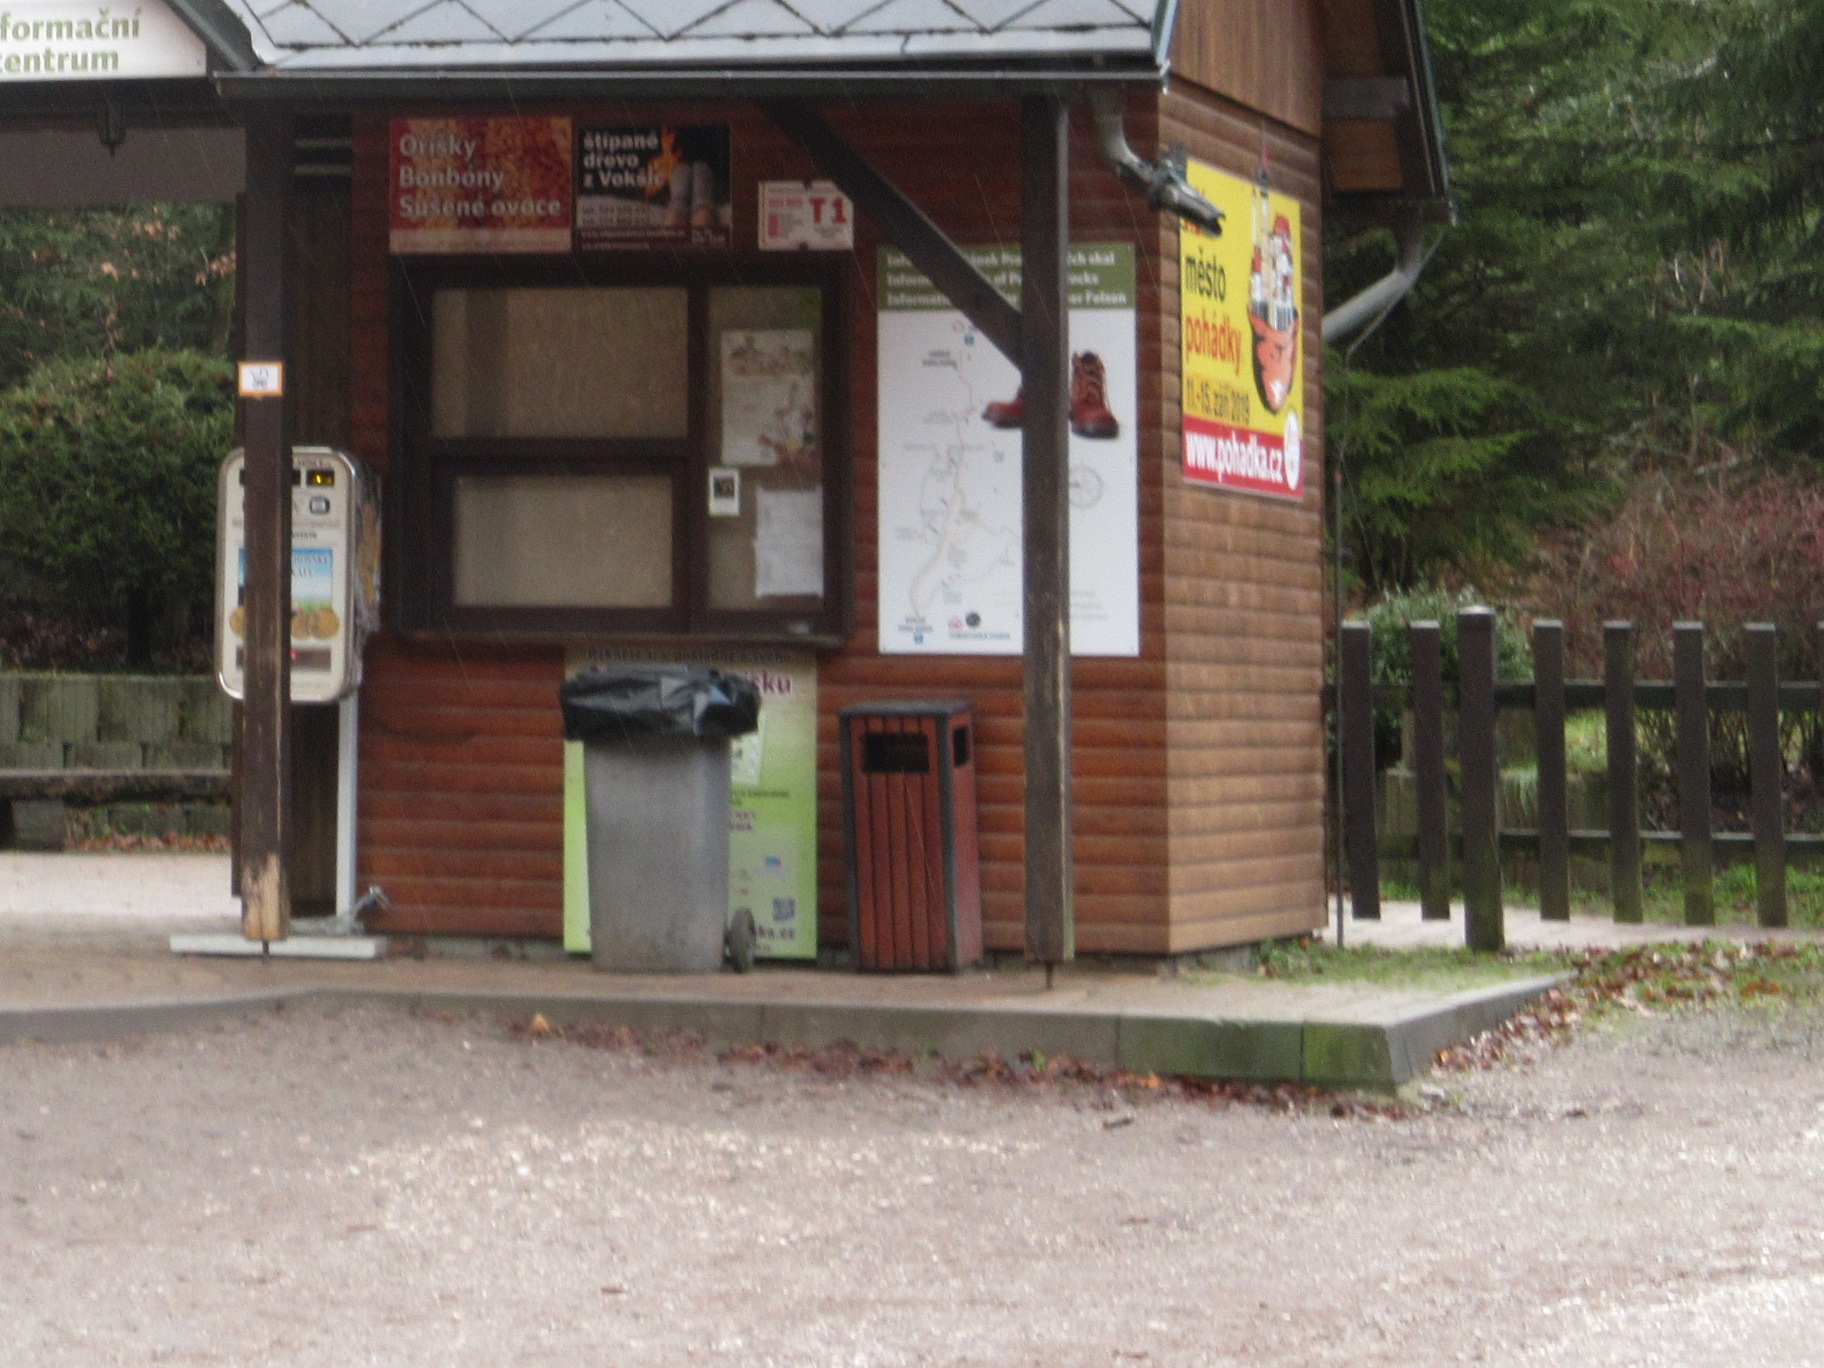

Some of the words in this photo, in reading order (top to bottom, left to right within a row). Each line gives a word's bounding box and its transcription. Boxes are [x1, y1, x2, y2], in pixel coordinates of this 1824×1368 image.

[399, 164, 505, 193] Bonbóny
[1185, 246, 1226, 302] město
[1185, 307, 1243, 376] pohádky
[1185, 430, 1283, 484] www.pohadka.cz
